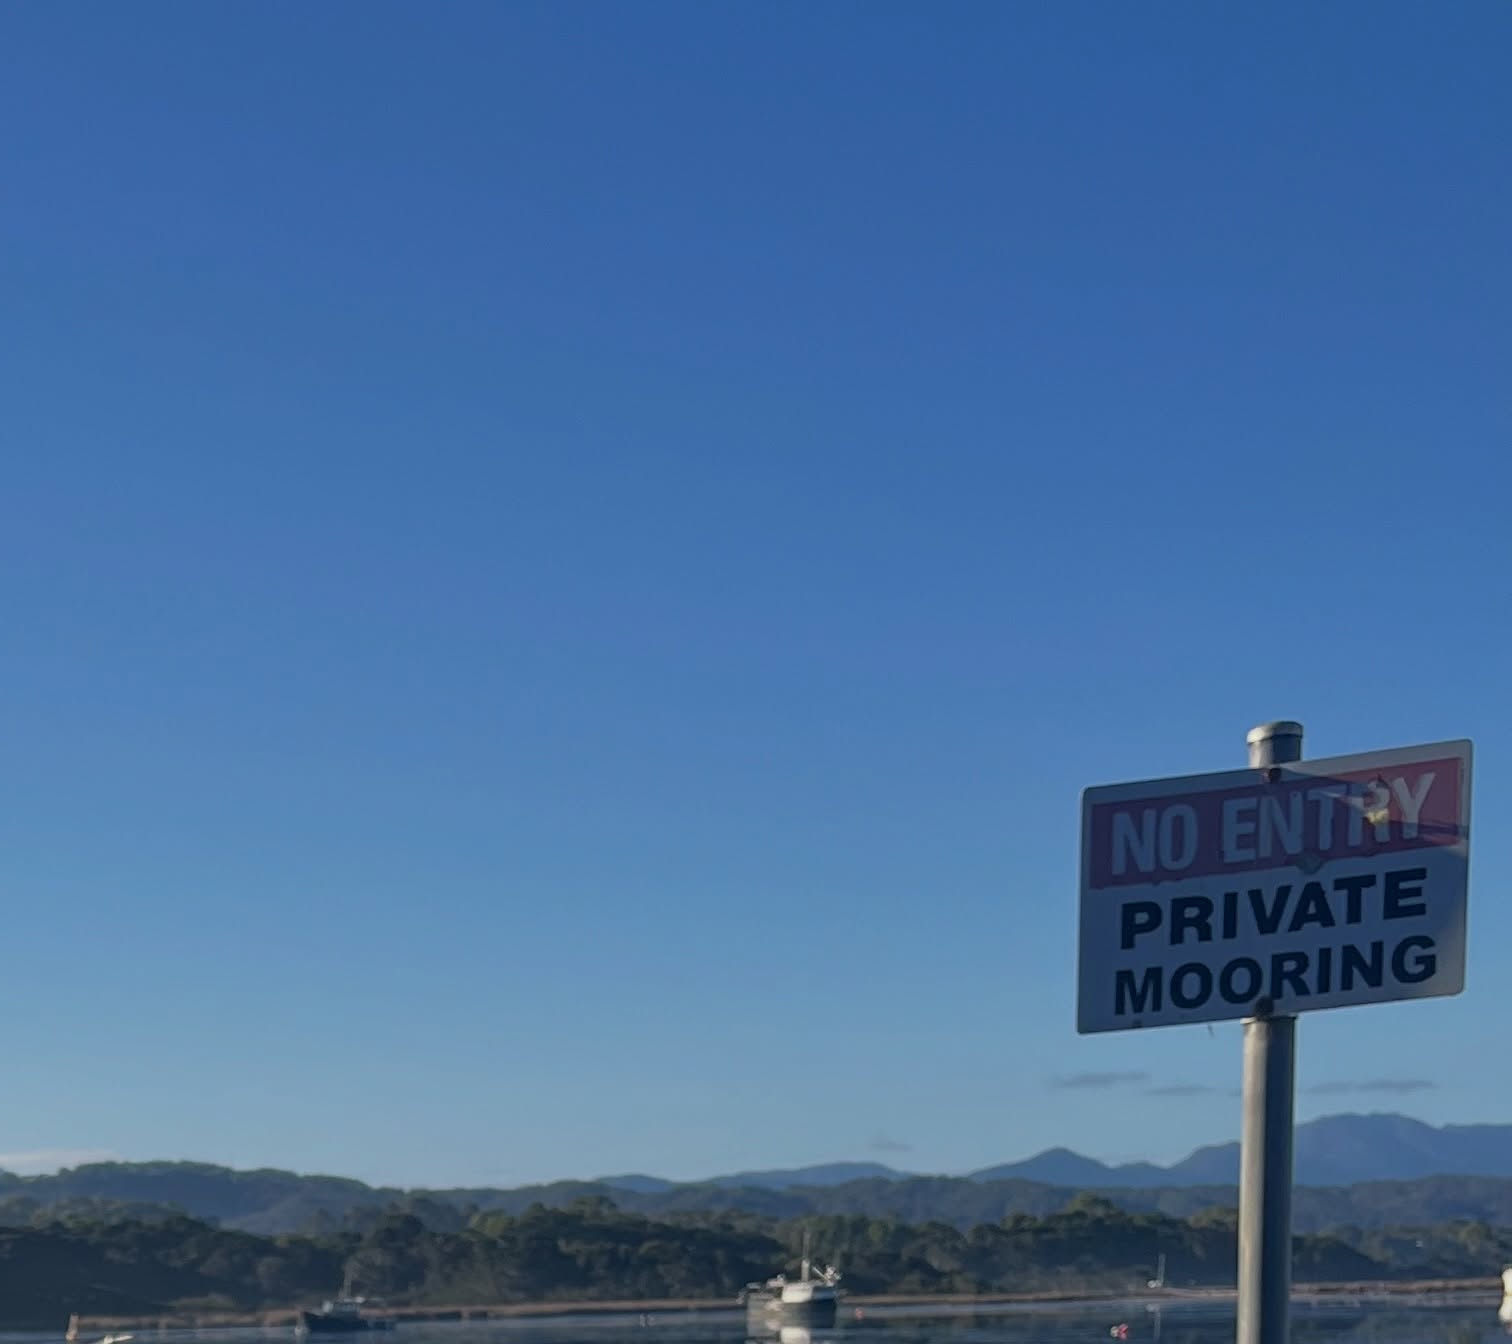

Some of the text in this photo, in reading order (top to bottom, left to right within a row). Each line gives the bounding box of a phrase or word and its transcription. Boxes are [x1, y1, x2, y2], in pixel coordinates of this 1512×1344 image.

[1111, 772, 1436, 876] NO ENTRY
[1119, 867, 1428, 951] PRIVATE
[1114, 934, 1437, 1016] MOORING
